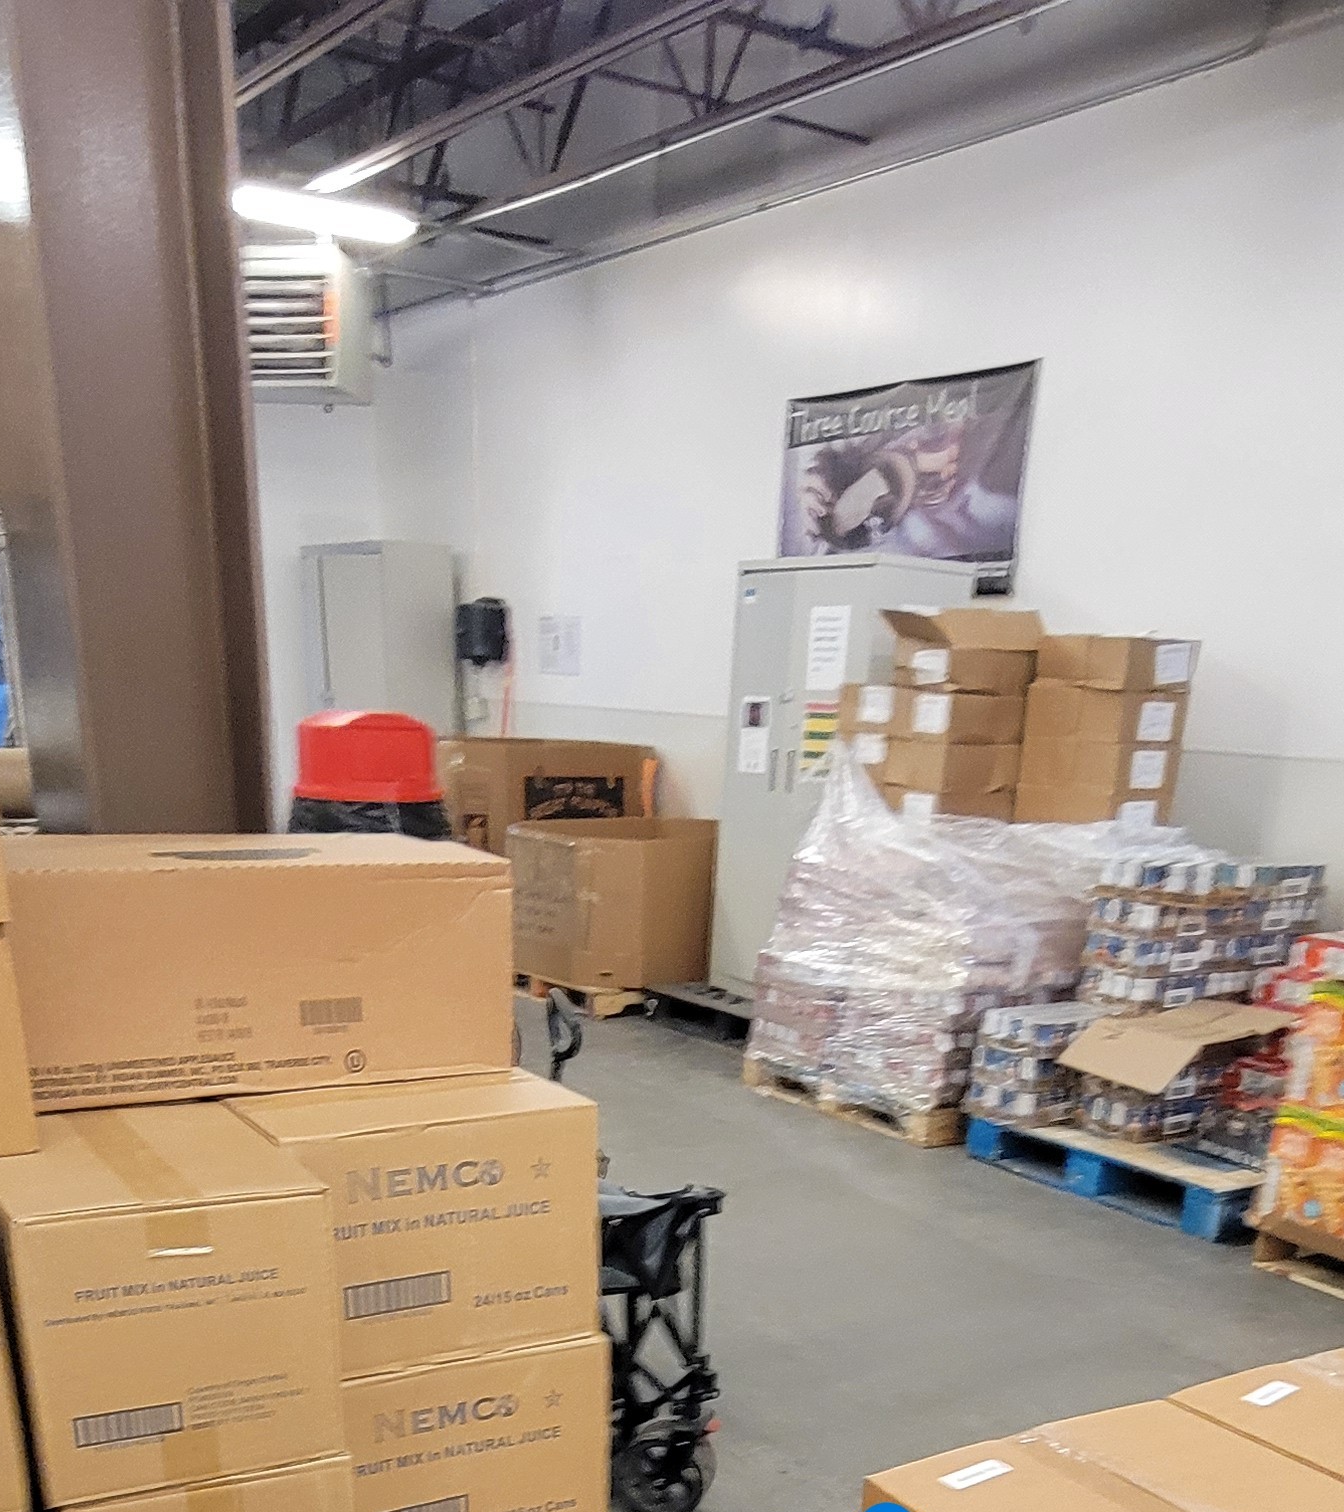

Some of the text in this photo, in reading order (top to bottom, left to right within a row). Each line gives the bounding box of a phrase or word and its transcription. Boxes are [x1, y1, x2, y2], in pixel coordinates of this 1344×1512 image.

[345, 1158, 504, 1205] NEMCO
[333, 1200, 552, 1242] RUIT MIX in NATURAL JUICE
[74, 1286, 120, 1304] FRUIT
[122, 1282, 148, 1297] MIX
[168, 1274, 235, 1291] NATURAL
[238, 1268, 279, 1284] JUICE
[474, 1284, 570, 1309] 24/15 oz Cans
[373, 1393, 520, 1444] NEMCO
[353, 1458, 393, 1478] RUIT
[396, 1452, 424, 1467] MIX
[444, 1435, 515, 1459] NATURAL
[518, 1425, 562, 1444] JUICE
